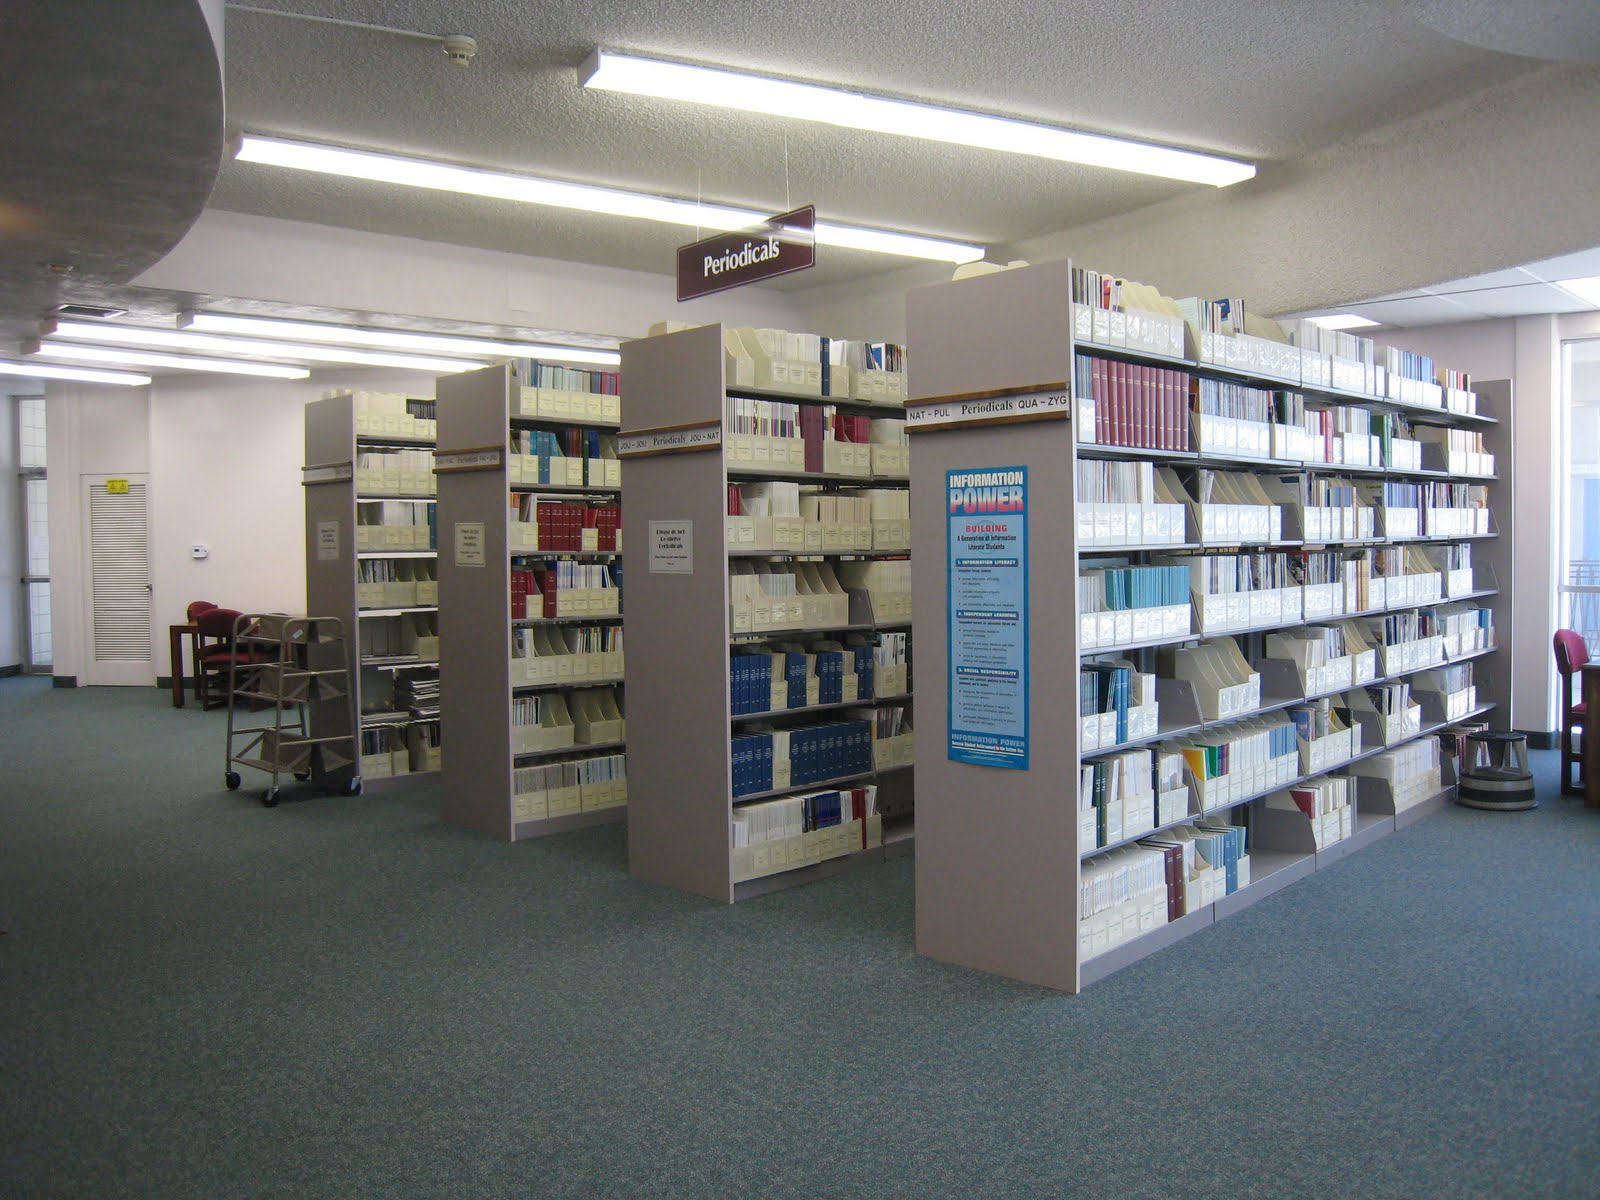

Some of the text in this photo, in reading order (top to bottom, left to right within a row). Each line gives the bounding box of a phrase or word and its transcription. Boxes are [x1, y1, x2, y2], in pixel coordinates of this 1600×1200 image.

[704, 236, 780, 277] Periodicals
[909, 411, 926, 420] NAT
[934, 408, 950, 418] PUL
[961, 399, 1013, 415] Periodicals
[1018, 399, 1038, 409] QUA
[1048, 395, 1067, 406] ZYG
[653, 435, 686, 446] Periodicals
[689, 434, 702, 442] JOU
[707, 431, 719, 440] NAT
[949, 471, 1023, 488] INFORMATION
[950, 486, 1024, 513] POWER
[965, 524, 1007, 533] BUILDING
[951, 733, 1025, 747] INFORMATION POWER
